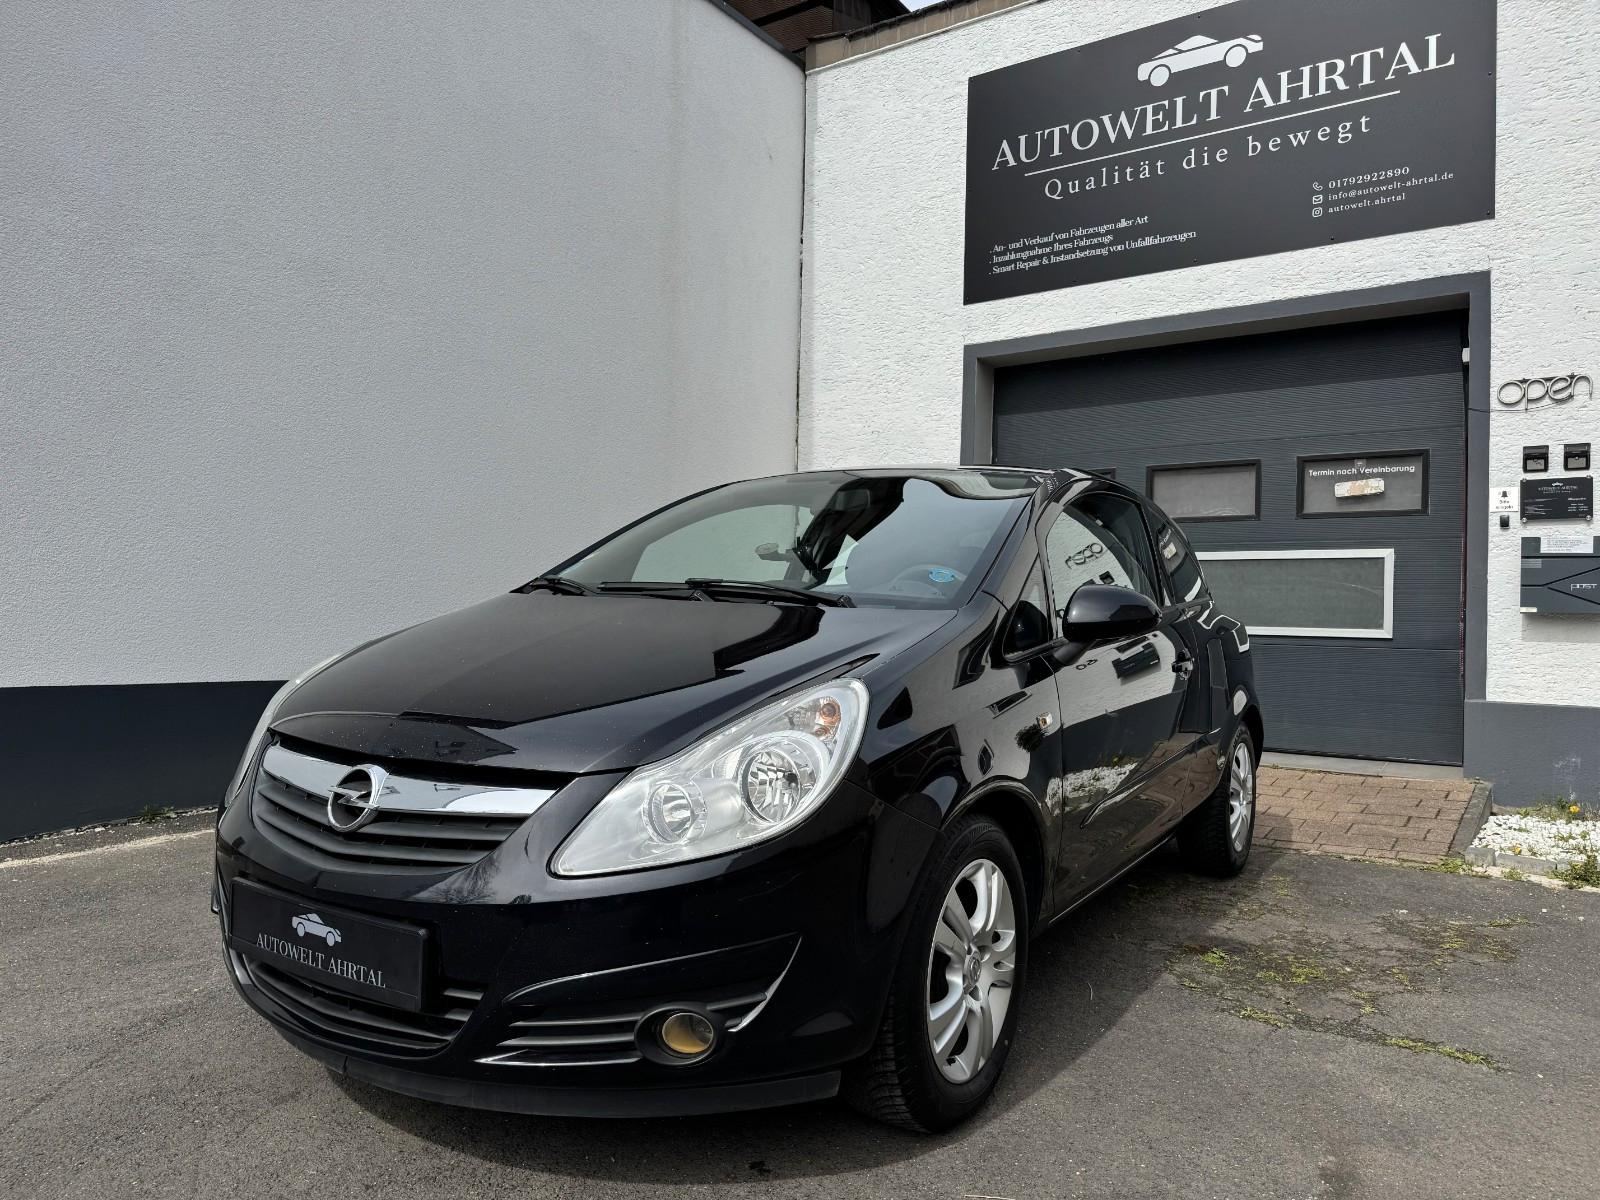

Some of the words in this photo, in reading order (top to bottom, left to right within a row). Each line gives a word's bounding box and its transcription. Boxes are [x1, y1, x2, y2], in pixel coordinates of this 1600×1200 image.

[992, 85, 1229, 171] AUTOWELT
[1243, 33, 1455, 113] AHRTAL
[1044, 159, 1166, 200] Qualität
[1182, 146, 1228, 170] die
[1247, 115, 1371, 157] bewegt
[1328, 166, 1410, 189] 01792922890
[1328, 172, 1454, 201] info@autowelt-ahrtal.de
[1328, 193, 1406, 213] autowelt.ahrtal
[993, 246, 1052, 264] Inzahlungnahme
[1053, 242, 1073, 252] Ihres
[1074, 234, 1113, 248] Fahrzeugs
[1008, 238, 1023, 250] und
[1024, 232, 1055, 246] Verkauf
[1055, 232, 1069, 240] von
[1070, 223, 1115, 238] Fahrzeugen
[1116, 218, 1134, 229] aller
[1134, 215, 1149, 226] Art
[992, 263, 1016, 274] Smart
[1016, 259, 1041, 271] Repair
[1042, 256, 1049, 265] &
[1050, 246, 1109, 264] Instandsetzung
[1109, 244, 1125, 253] von
[1125, 231, 1197, 250] Unfallfahrzeugen
[1497, 374, 1593, 411] open
[1308, 469, 1335, 477] Termin
[1336, 467, 1357, 476] nach
[1359, 465, 1416, 475] Vereinbarung
[256, 932, 325, 969] AUTOWELT
[327, 956, 386, 989] AHRTAL
